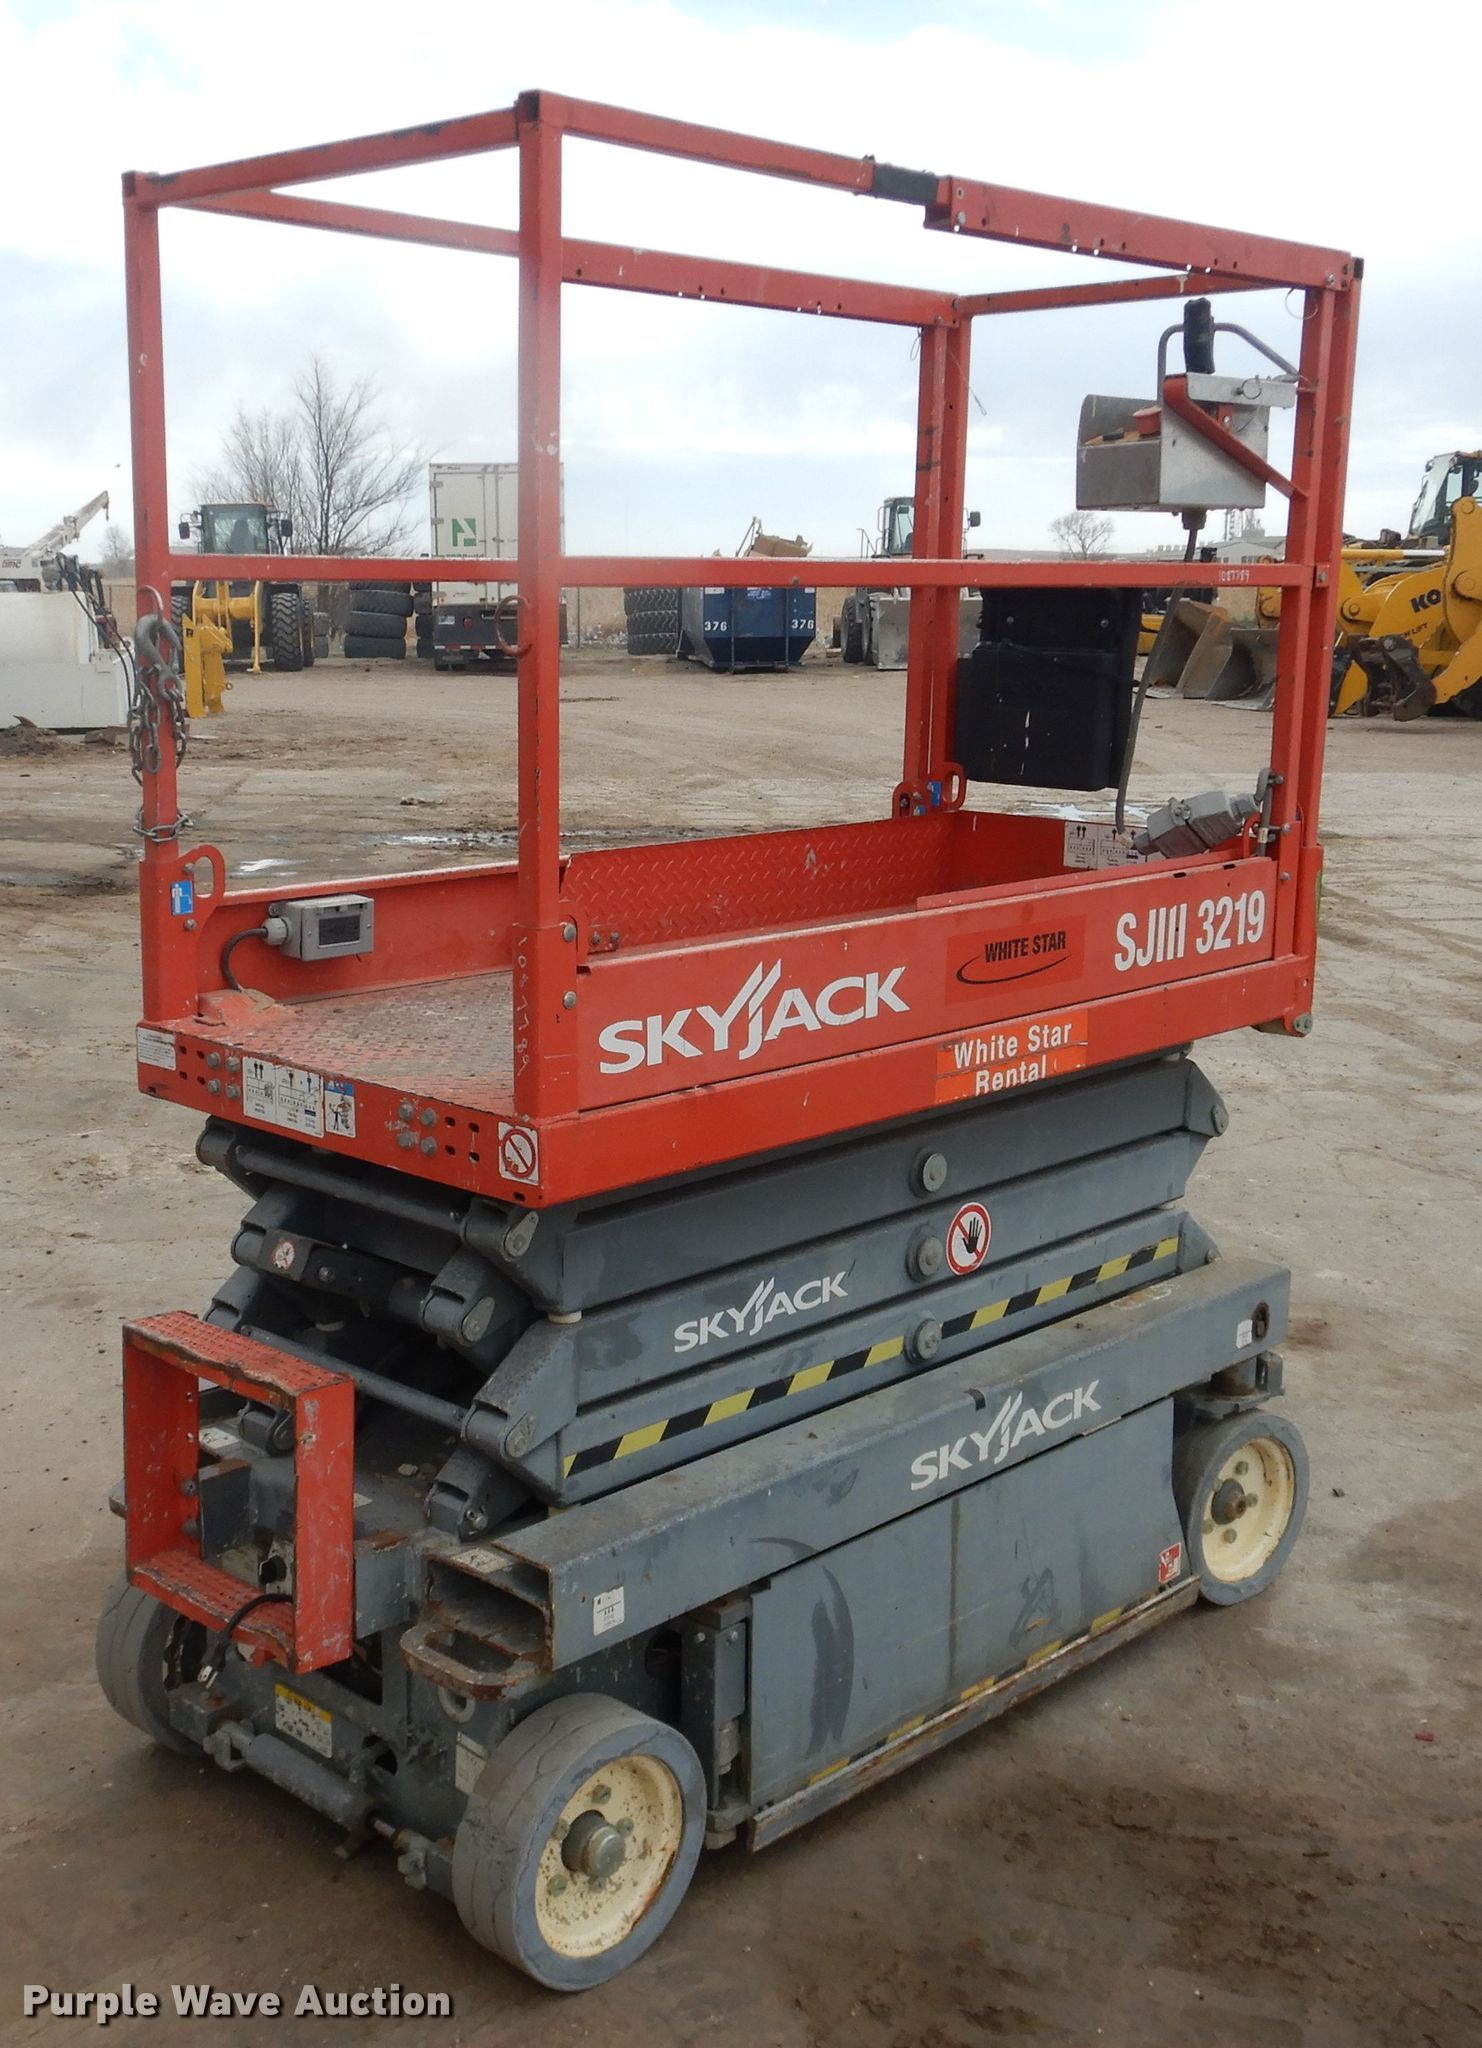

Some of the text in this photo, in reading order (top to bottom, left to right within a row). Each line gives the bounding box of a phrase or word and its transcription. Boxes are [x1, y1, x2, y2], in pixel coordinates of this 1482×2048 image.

[704, 621, 728, 632] 376
[984, 931, 1066, 963] WHITE STAR
[1196, 890, 1265, 953] 3219
[598, 958, 911, 1075] SKYJACK
[954, 1023, 1072, 1069] White Star
[976, 1055, 1047, 1096] Rental
[674, 1271, 848, 1352] SKYJACK
[911, 1379, 1102, 1491] SKYJACK
